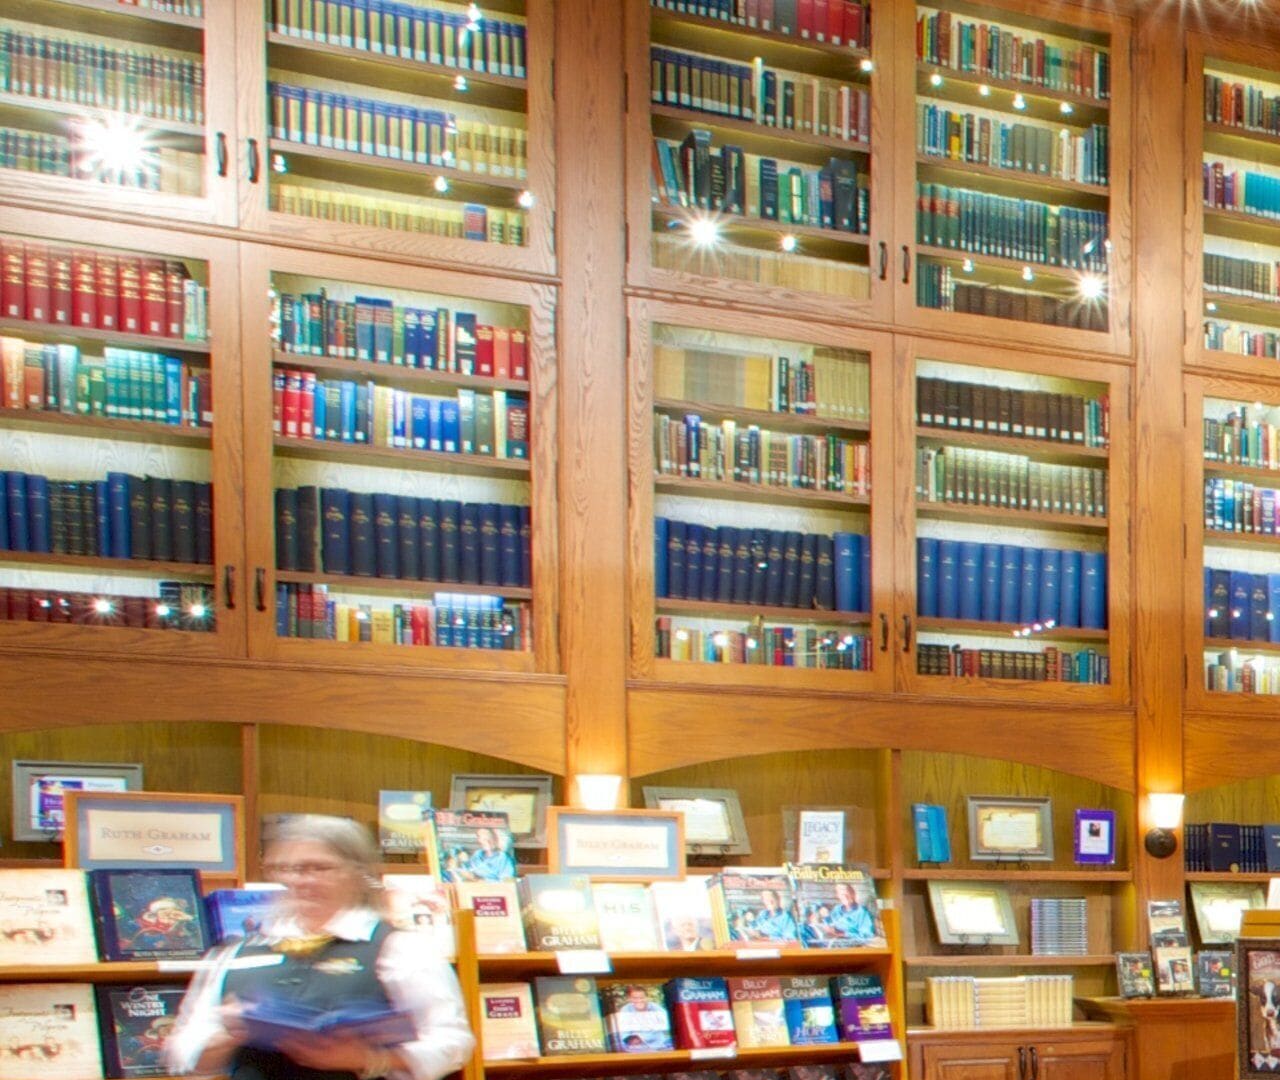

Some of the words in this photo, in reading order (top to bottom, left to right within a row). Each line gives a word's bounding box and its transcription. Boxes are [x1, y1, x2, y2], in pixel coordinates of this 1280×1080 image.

[102, 827, 141, 839] RUTH
[148, 829, 211, 841] GRAHAM
[795, 866, 818, 881] Billy
[819, 866, 865, 881] Graham
[604, 903, 641, 914] HIS
[542, 935, 599, 947] GRAHAM
[685, 978, 713, 990] BILLY
[743, 979, 769, 990] BILLY
[791, 977, 816, 988] BILLY
[847, 976, 871, 987] BILLY
[680, 989, 726, 1001] GRAHAM
[734, 988, 780, 1000] GRAHAM
[783, 987, 828, 999] GRAHAM
[840, 985, 883, 997] GRAHAM
[548, 1039, 604, 1050] GRAHAM
